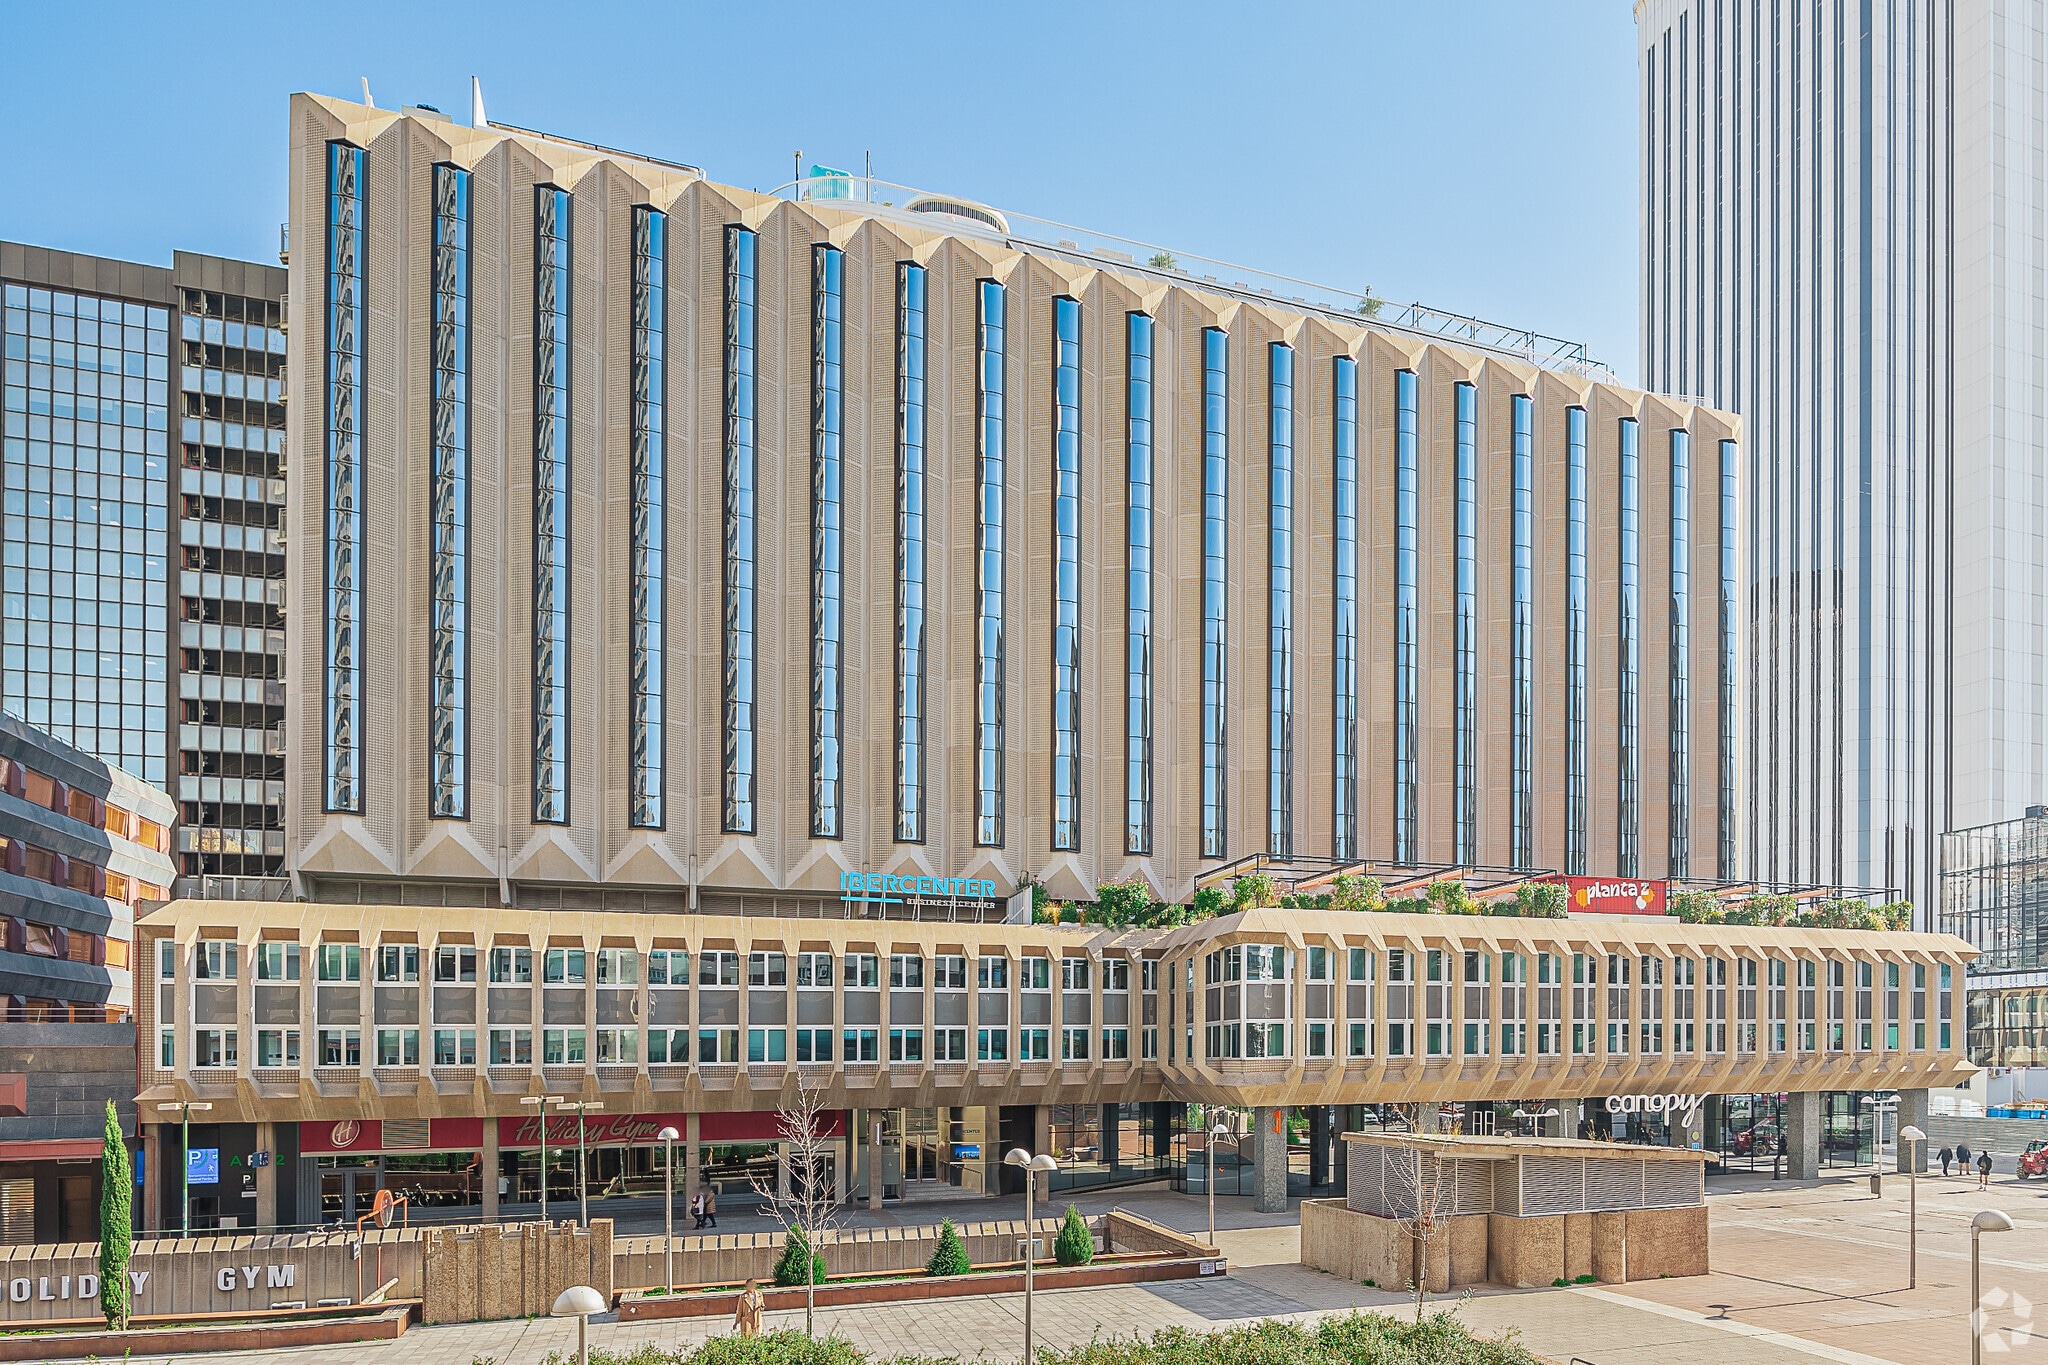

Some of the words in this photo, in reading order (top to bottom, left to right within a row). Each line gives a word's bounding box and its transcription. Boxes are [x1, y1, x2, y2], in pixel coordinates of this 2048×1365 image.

[840, 870, 996, 898] IBERCENTER
[1587, 881, 1638, 905] planta
[1605, 1091, 1712, 1128] canopy
[609, 1114, 660, 1150] Gym
[188, 1151, 202, 1166] P
[243, 1174, 251, 1184] P
[0, 1271, 150, 1302] OLIDY
[217, 1264, 295, 1291] GYM
